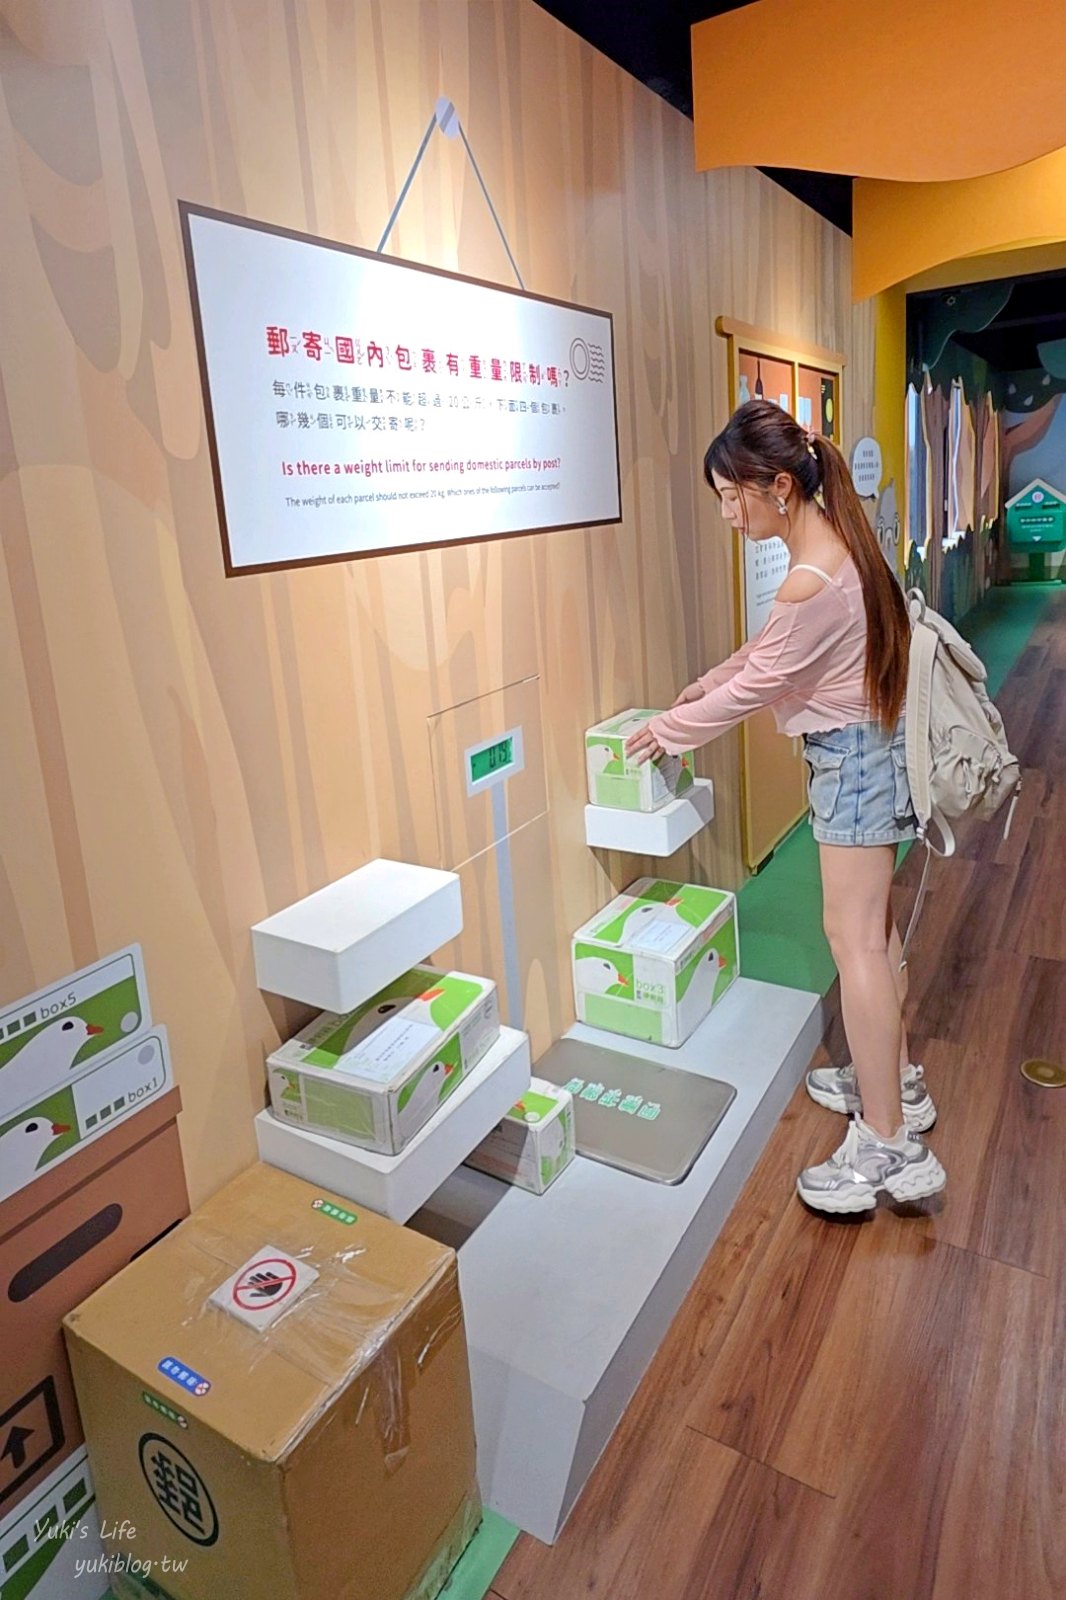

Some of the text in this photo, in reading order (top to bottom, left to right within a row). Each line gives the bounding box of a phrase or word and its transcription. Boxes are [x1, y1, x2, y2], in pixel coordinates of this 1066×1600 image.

[282, 457, 561, 477] Is there a weight limit for sending domestic parcels by post?
[285, 497, 300, 507] The
[302, 495, 326, 508] weight
[328, 494, 335, 505] of
[336, 494, 353, 504] each
[354, 493, 375, 504] parcel
[376, 491, 397, 502] should
[399, 491, 409, 500] not
[410, 489, 429, 499] exceed
[447, 487, 462, 497] Which
[40, 991, 77, 1019] box5
[128, 1077, 157, 1103] box1
